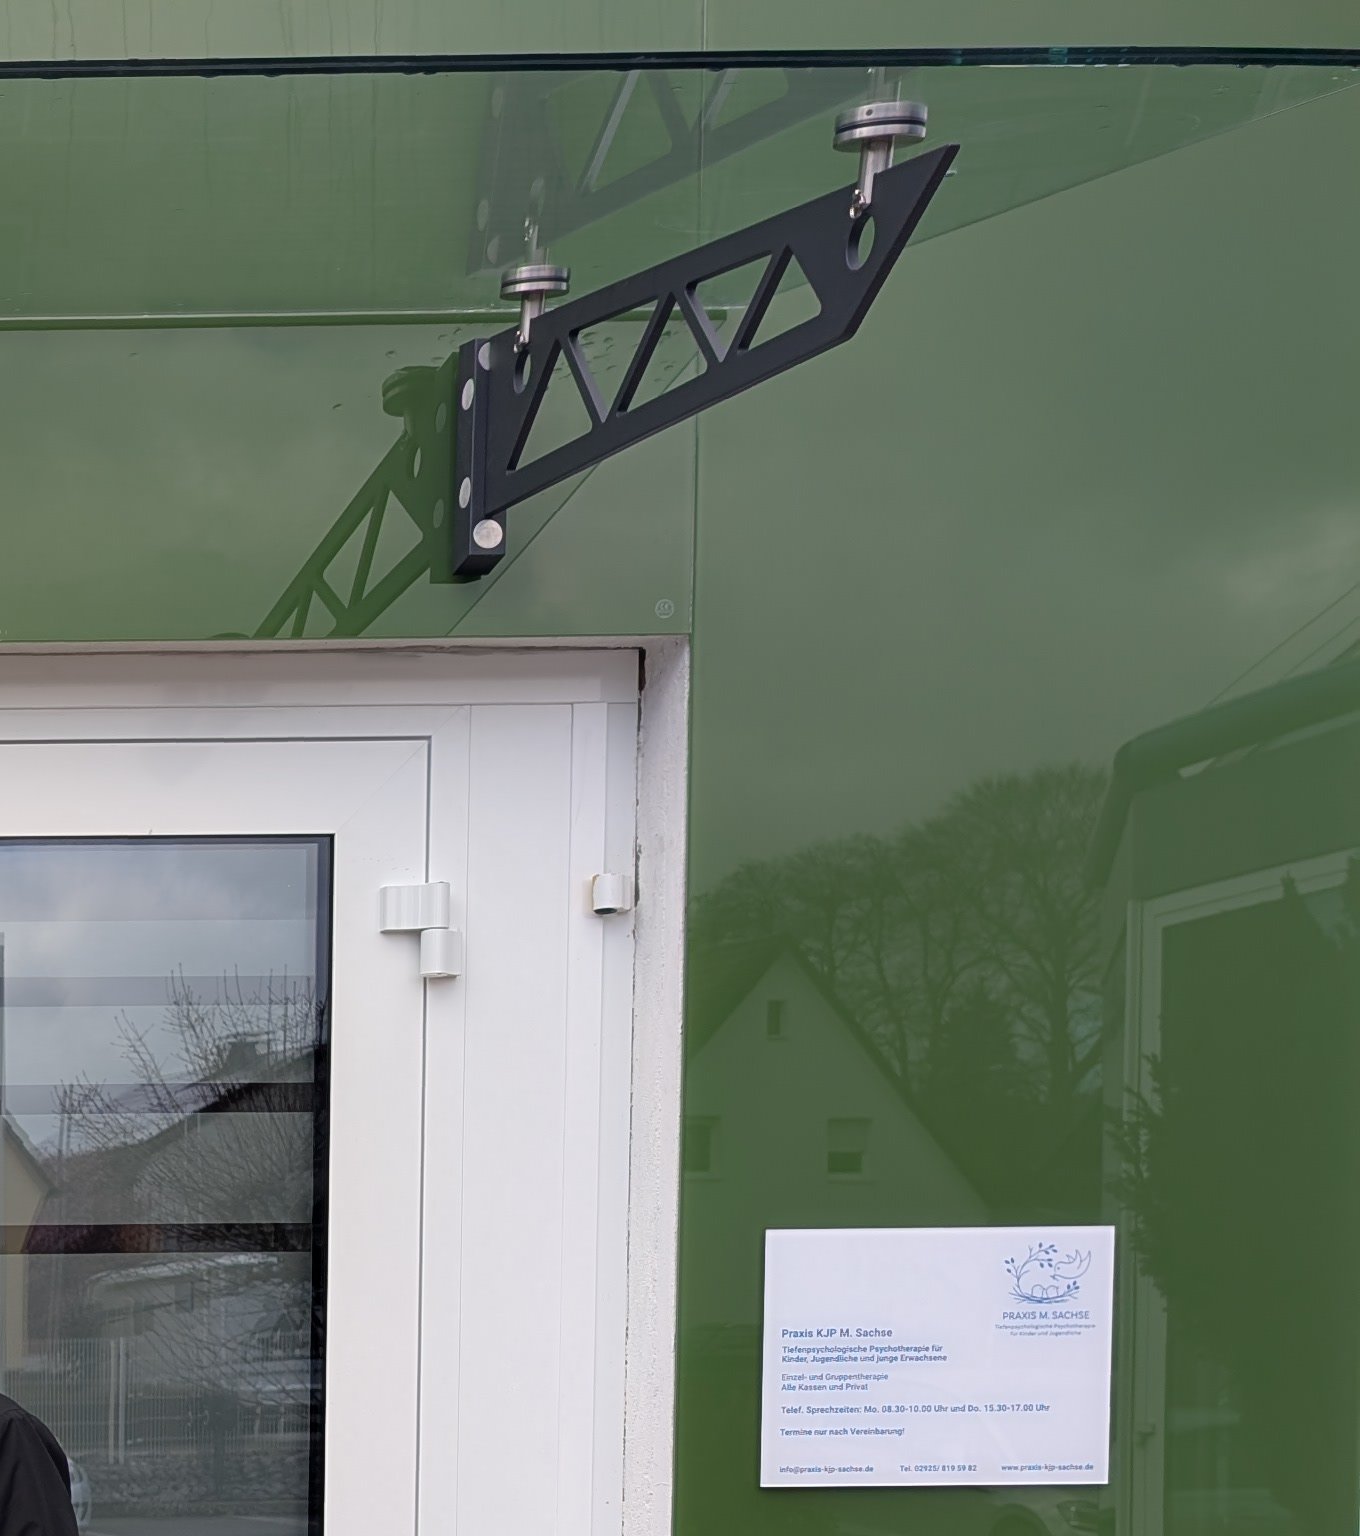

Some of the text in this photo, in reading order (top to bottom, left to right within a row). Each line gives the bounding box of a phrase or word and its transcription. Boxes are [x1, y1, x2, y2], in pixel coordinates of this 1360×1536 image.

[1003, 1311, 1090, 1320] PRAXIS M. SACHSE
[781, 1328, 893, 1339] Praxis KJP M. Sachse
[782, 1343, 944, 1354] Tiefenpsychologische Psychotherapie für
[781, 1354, 948, 1364] Kinder, Jugendliche und junge Erwachsene
[781, 1373, 889, 1383] Einzel- und Gruppentherapie
[781, 1383, 869, 1391] Alle Kassen und Privat
[781, 1403, 1051, 1415] Telef. Sprechzeiten: Mo. 08.30-10.00 Uhr und Do. 15.30-17.00 Uhr
[780, 1428, 813, 1436] Termine
[829, 1427, 849, 1436] nach
[850, 1427, 906, 1437] Vereinbarung!
[780, 1464, 875, 1474] info@praxis-kjp-sachse.de
[900, 1465, 913, 1473] Tel.
[1001, 1463, 1095, 1472] www.praxis-kjp-sachse.de
